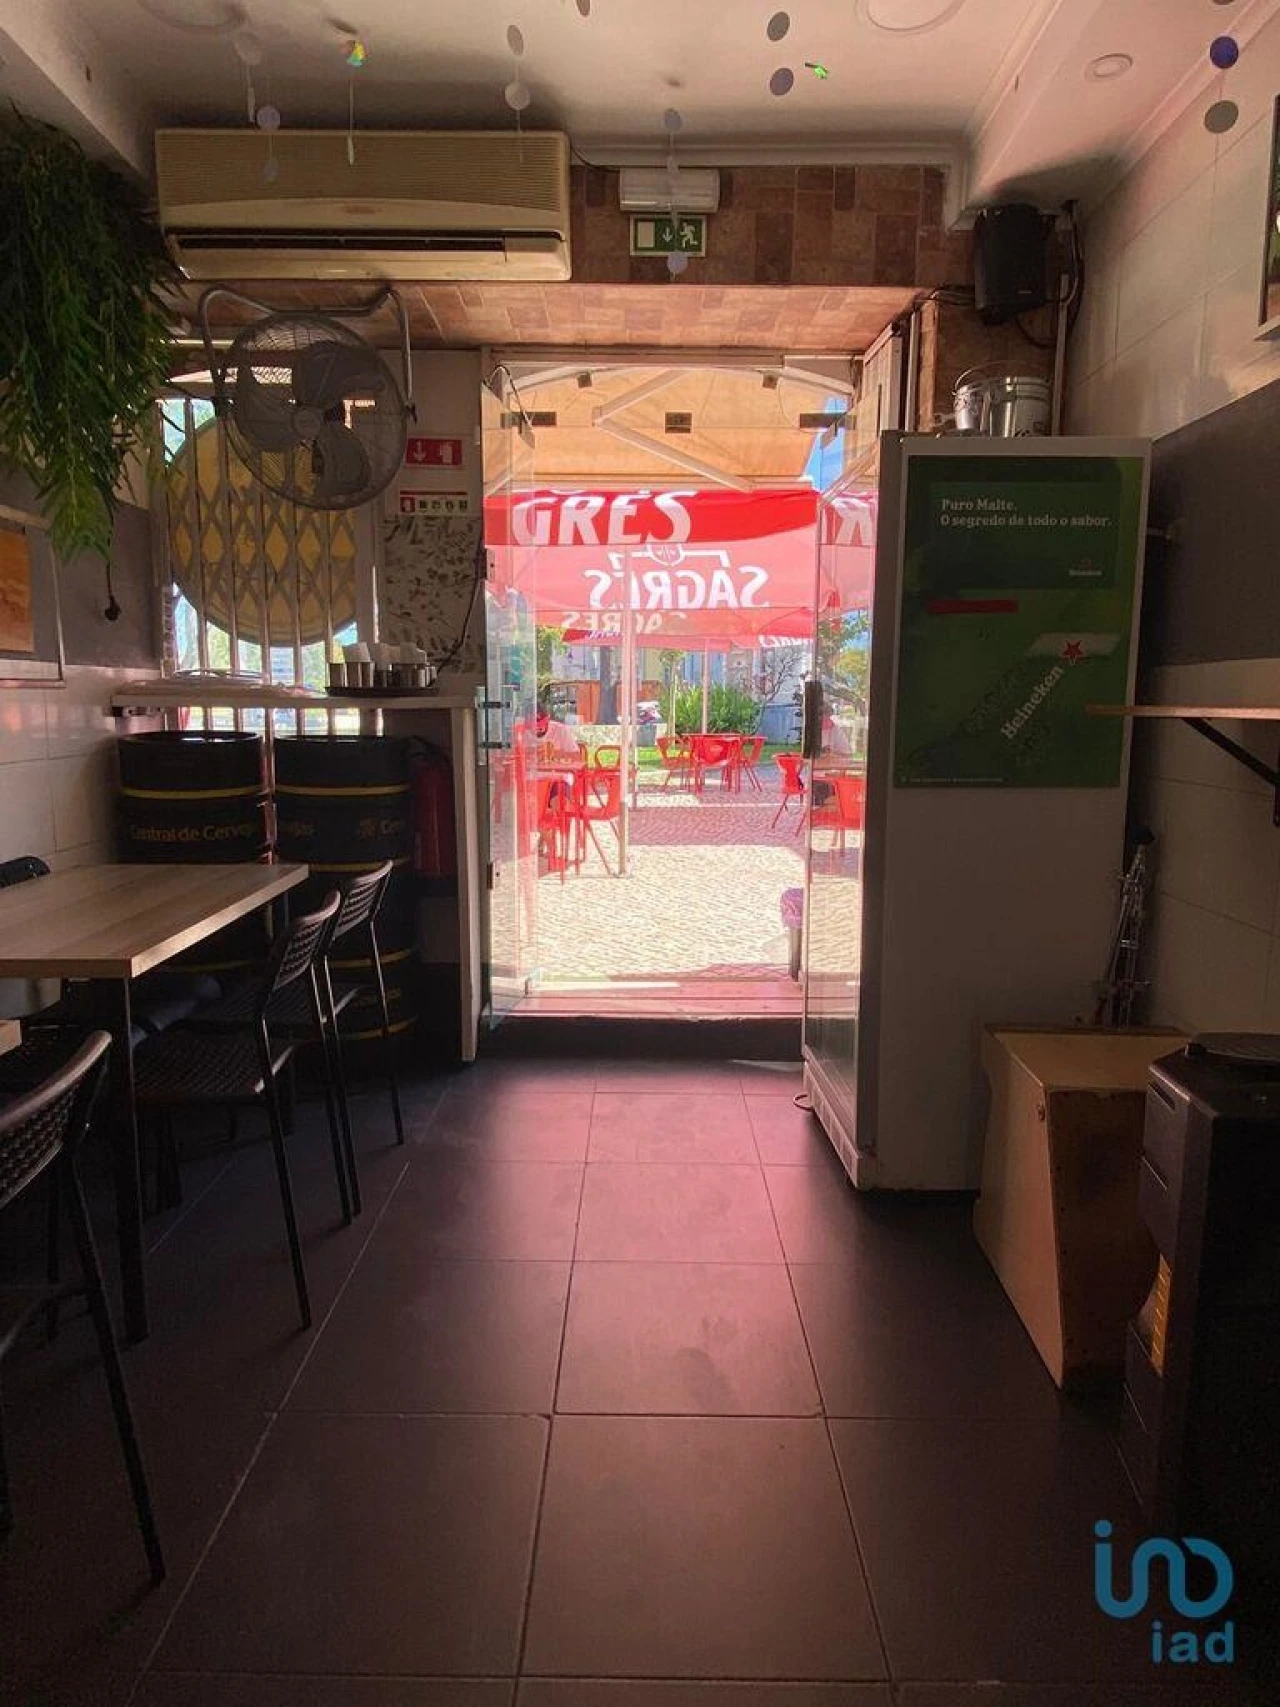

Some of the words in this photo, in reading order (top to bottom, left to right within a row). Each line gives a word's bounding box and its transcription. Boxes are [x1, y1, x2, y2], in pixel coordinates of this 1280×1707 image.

[941, 498, 974, 511] Puro
[977, 498, 1018, 511] Malte.
[940, 515, 951, 526] O
[952, 515, 1006, 529] segredo
[1009, 515, 1025, 526] de
[1028, 515, 1058, 526] todo
[1059, 518, 1069, 526] o
